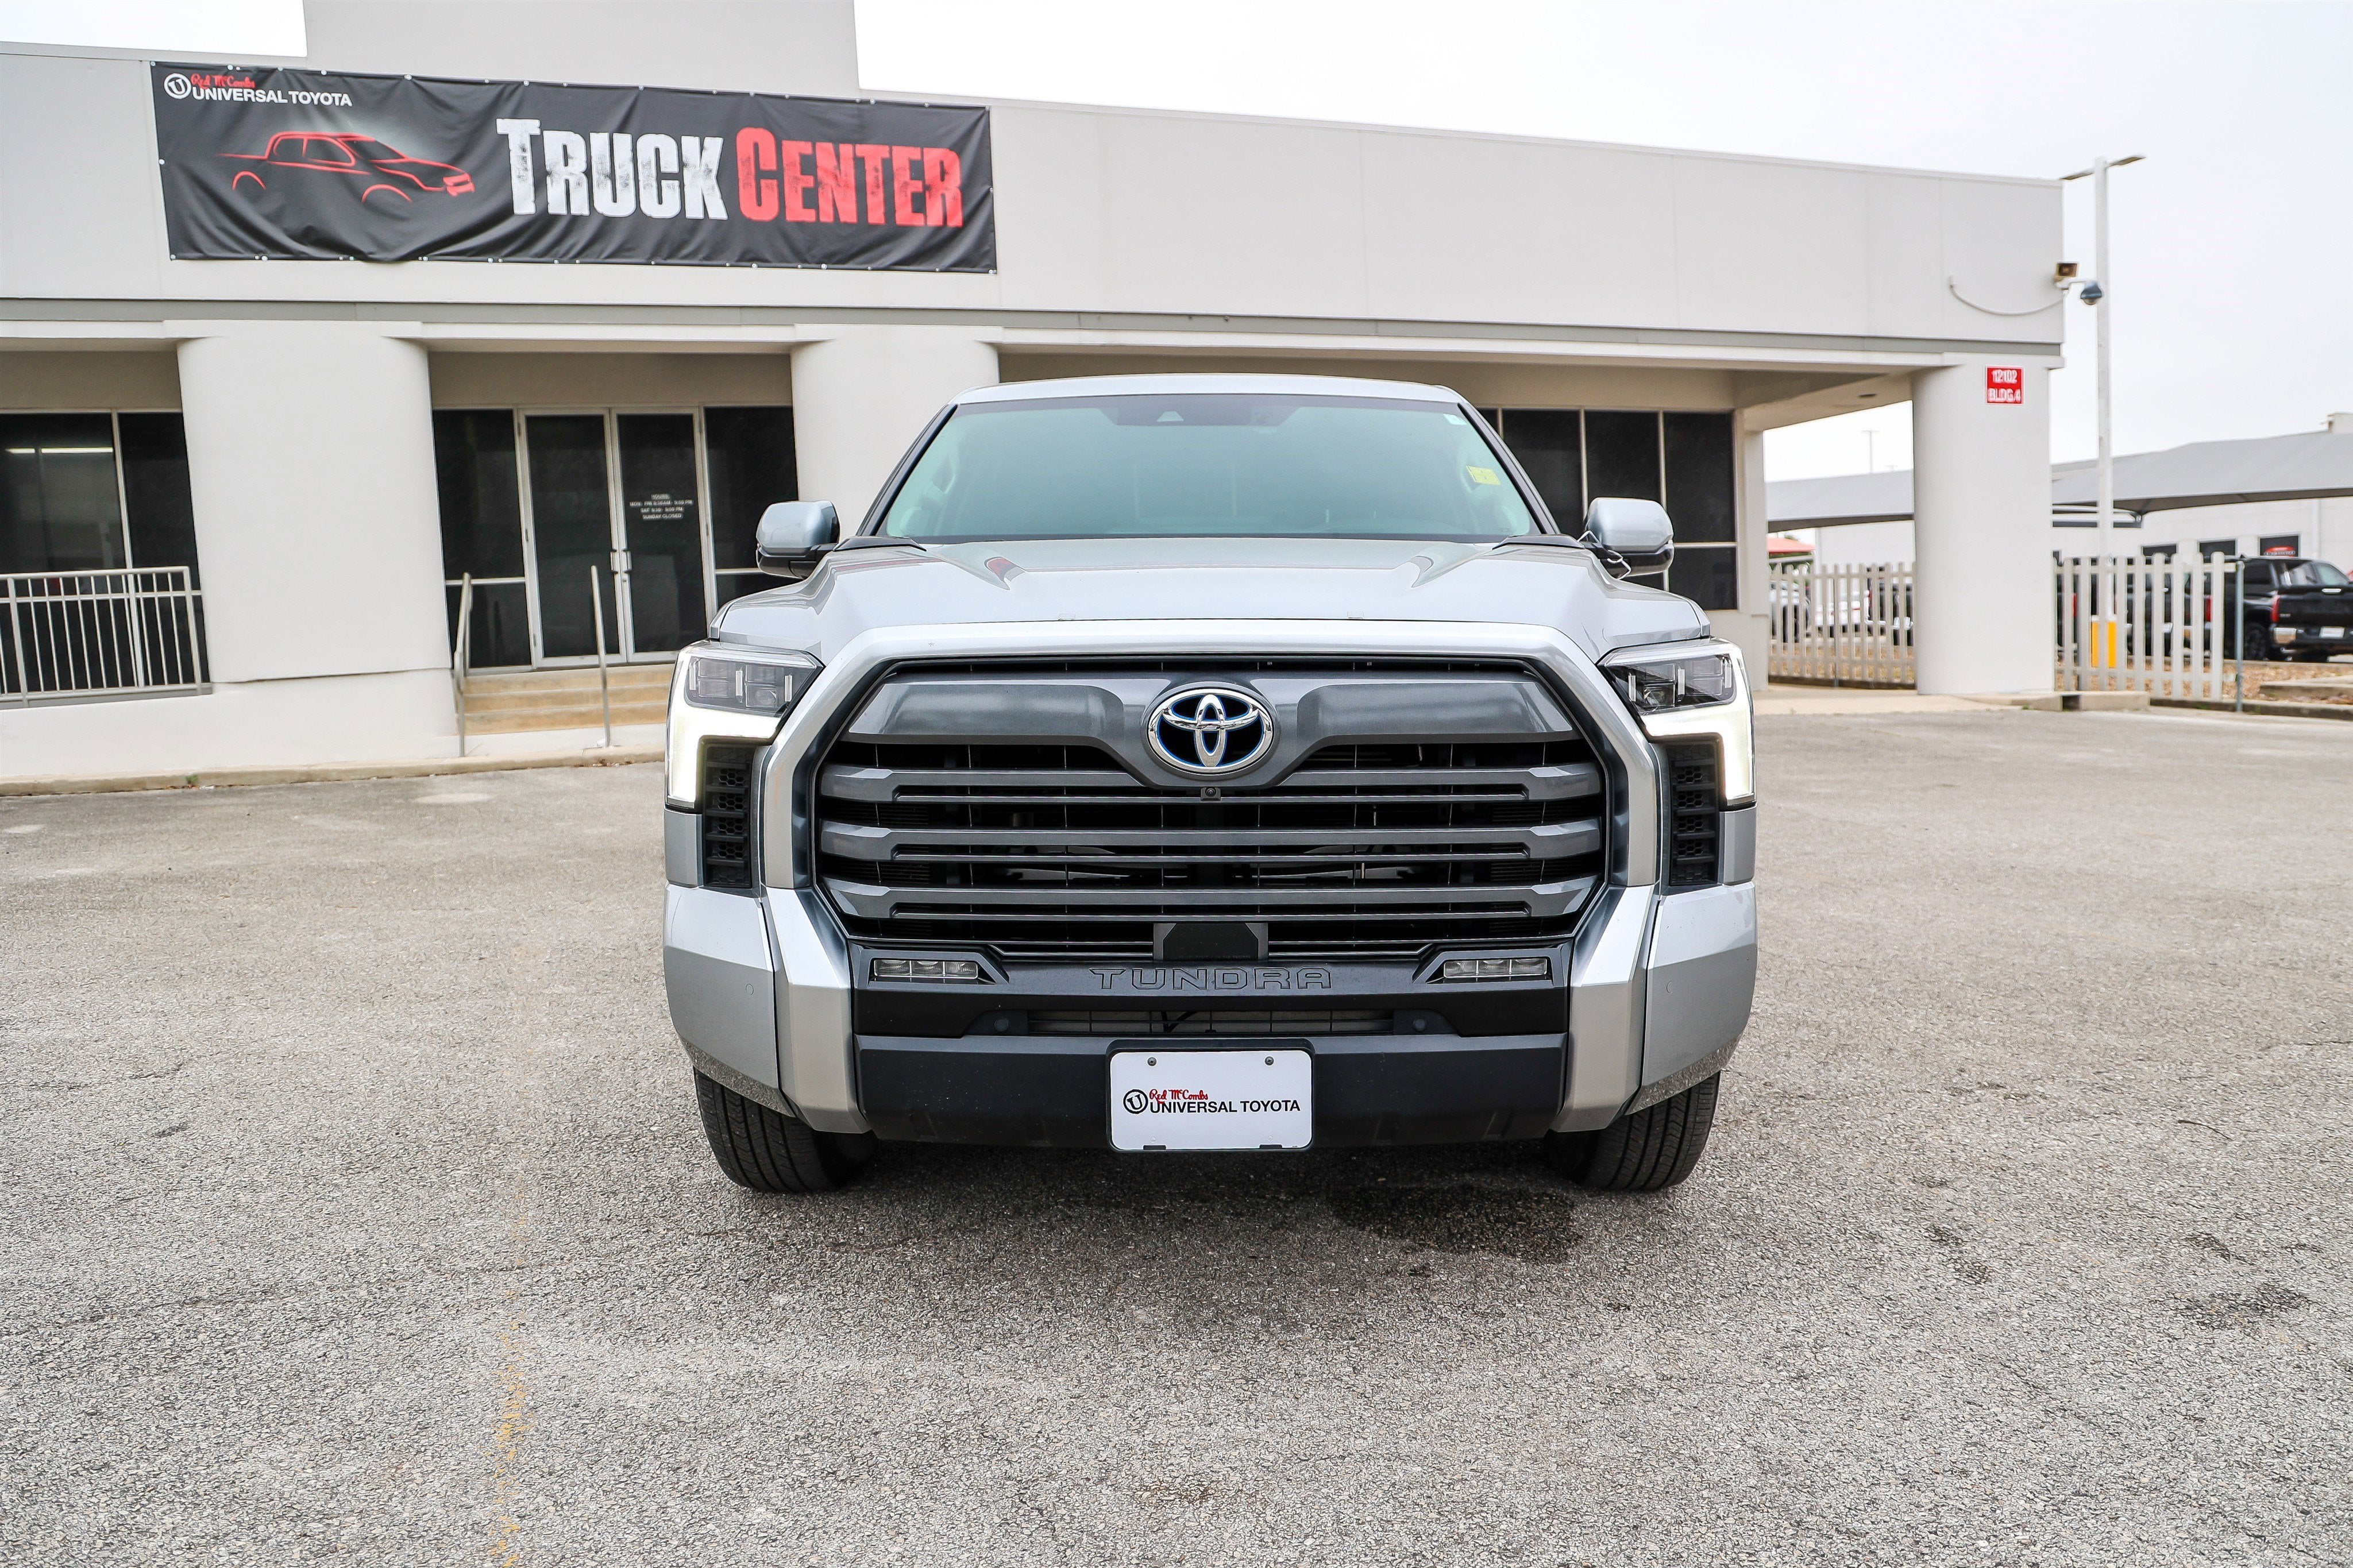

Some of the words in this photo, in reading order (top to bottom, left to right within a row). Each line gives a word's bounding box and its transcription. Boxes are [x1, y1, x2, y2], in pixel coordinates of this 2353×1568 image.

[192, 86, 288, 104] UNIVERSAL
[288, 90, 353, 107] TOYOTA
[496, 118, 728, 221] TRUCK
[735, 127, 964, 228] CENTER
[1988, 388, 2014, 403] BLDG
[1089, 967, 1332, 990] TUNDRA
[1149, 1089, 1167, 1104] Red
[1168, 1089, 1208, 1100] McCombs
[1150, 1101, 1237, 1113] UNIVERSAL
[1240, 1099, 1301, 1113] TOYOTA
